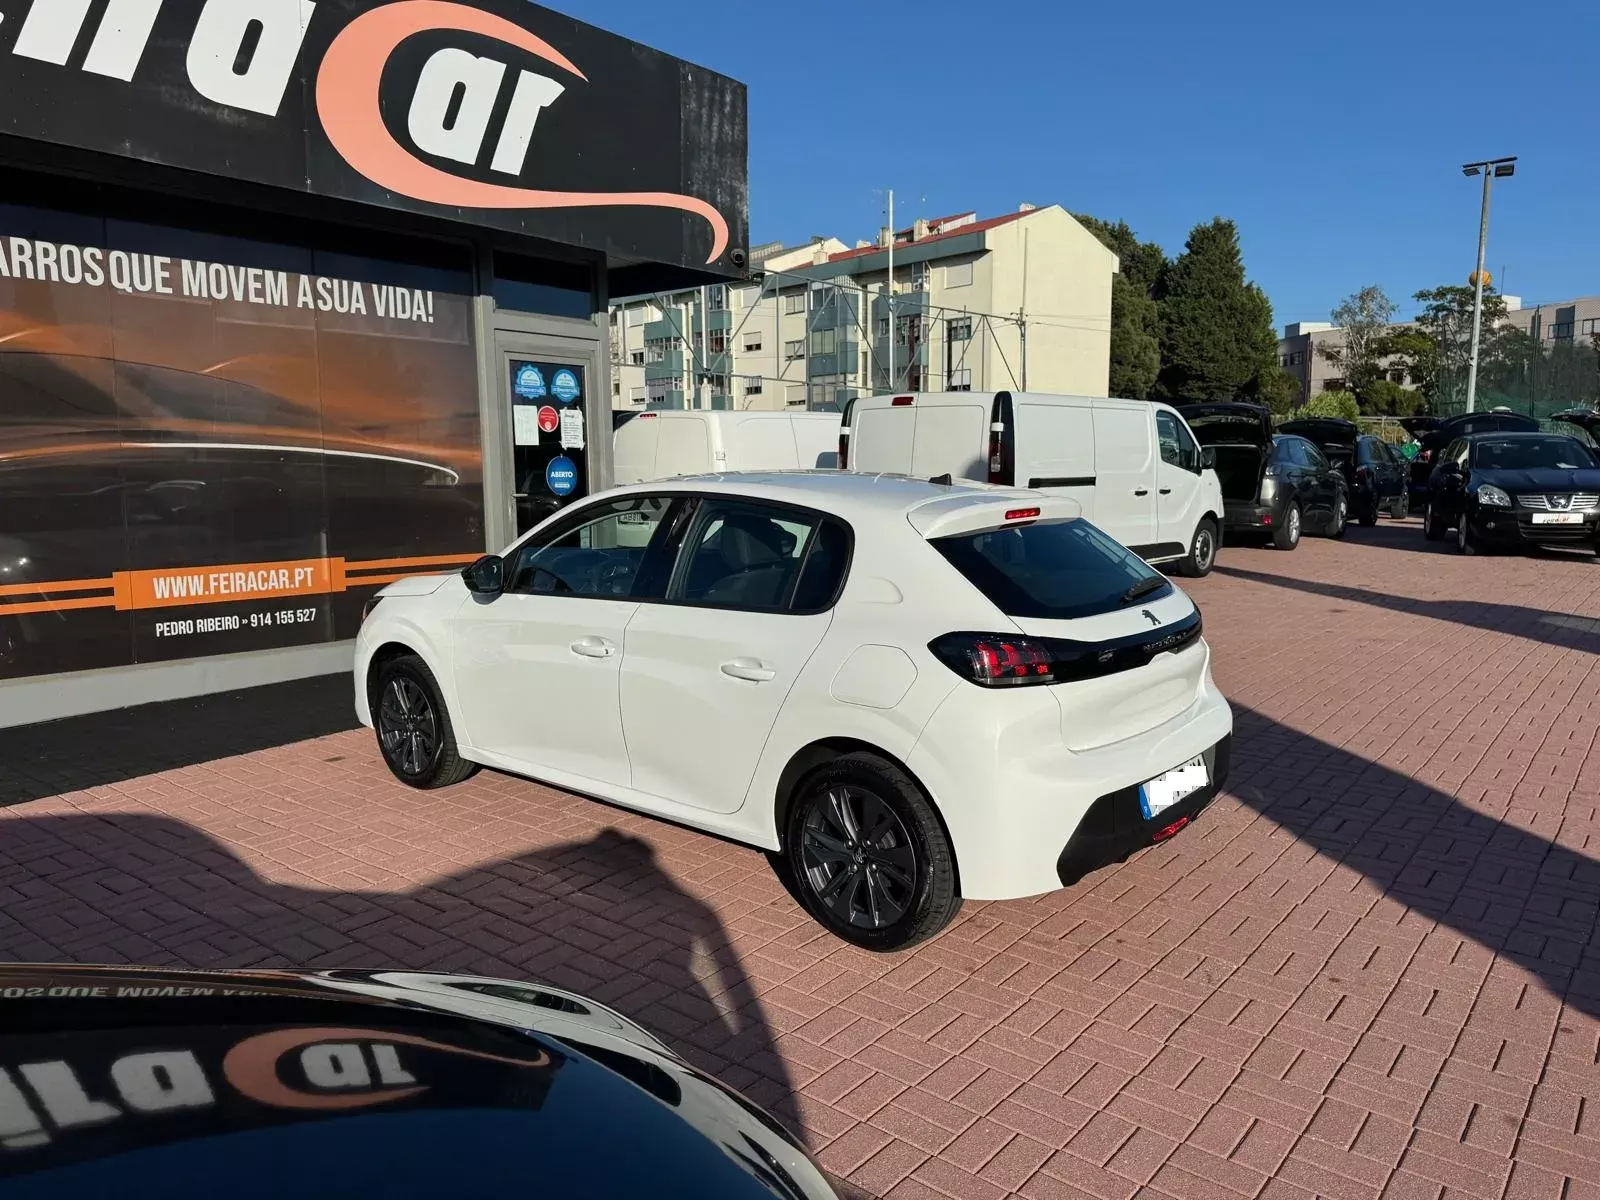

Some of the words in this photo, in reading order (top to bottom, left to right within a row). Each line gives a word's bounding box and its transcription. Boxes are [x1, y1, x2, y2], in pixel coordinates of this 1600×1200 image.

[108, 250, 173, 293] QUE
[181, 258, 289, 307] MOVEM
[371, 283, 434, 324] VIDA!
[152, 567, 314, 599] WWW.FEIRACAR.PT
[155, 619, 194, 637] PEDRO
[196, 615, 240, 633] RIBEIRO
[250, 611, 272, 627] 914
[274, 609, 295, 625] 155
[296, 607, 317, 622] 527
